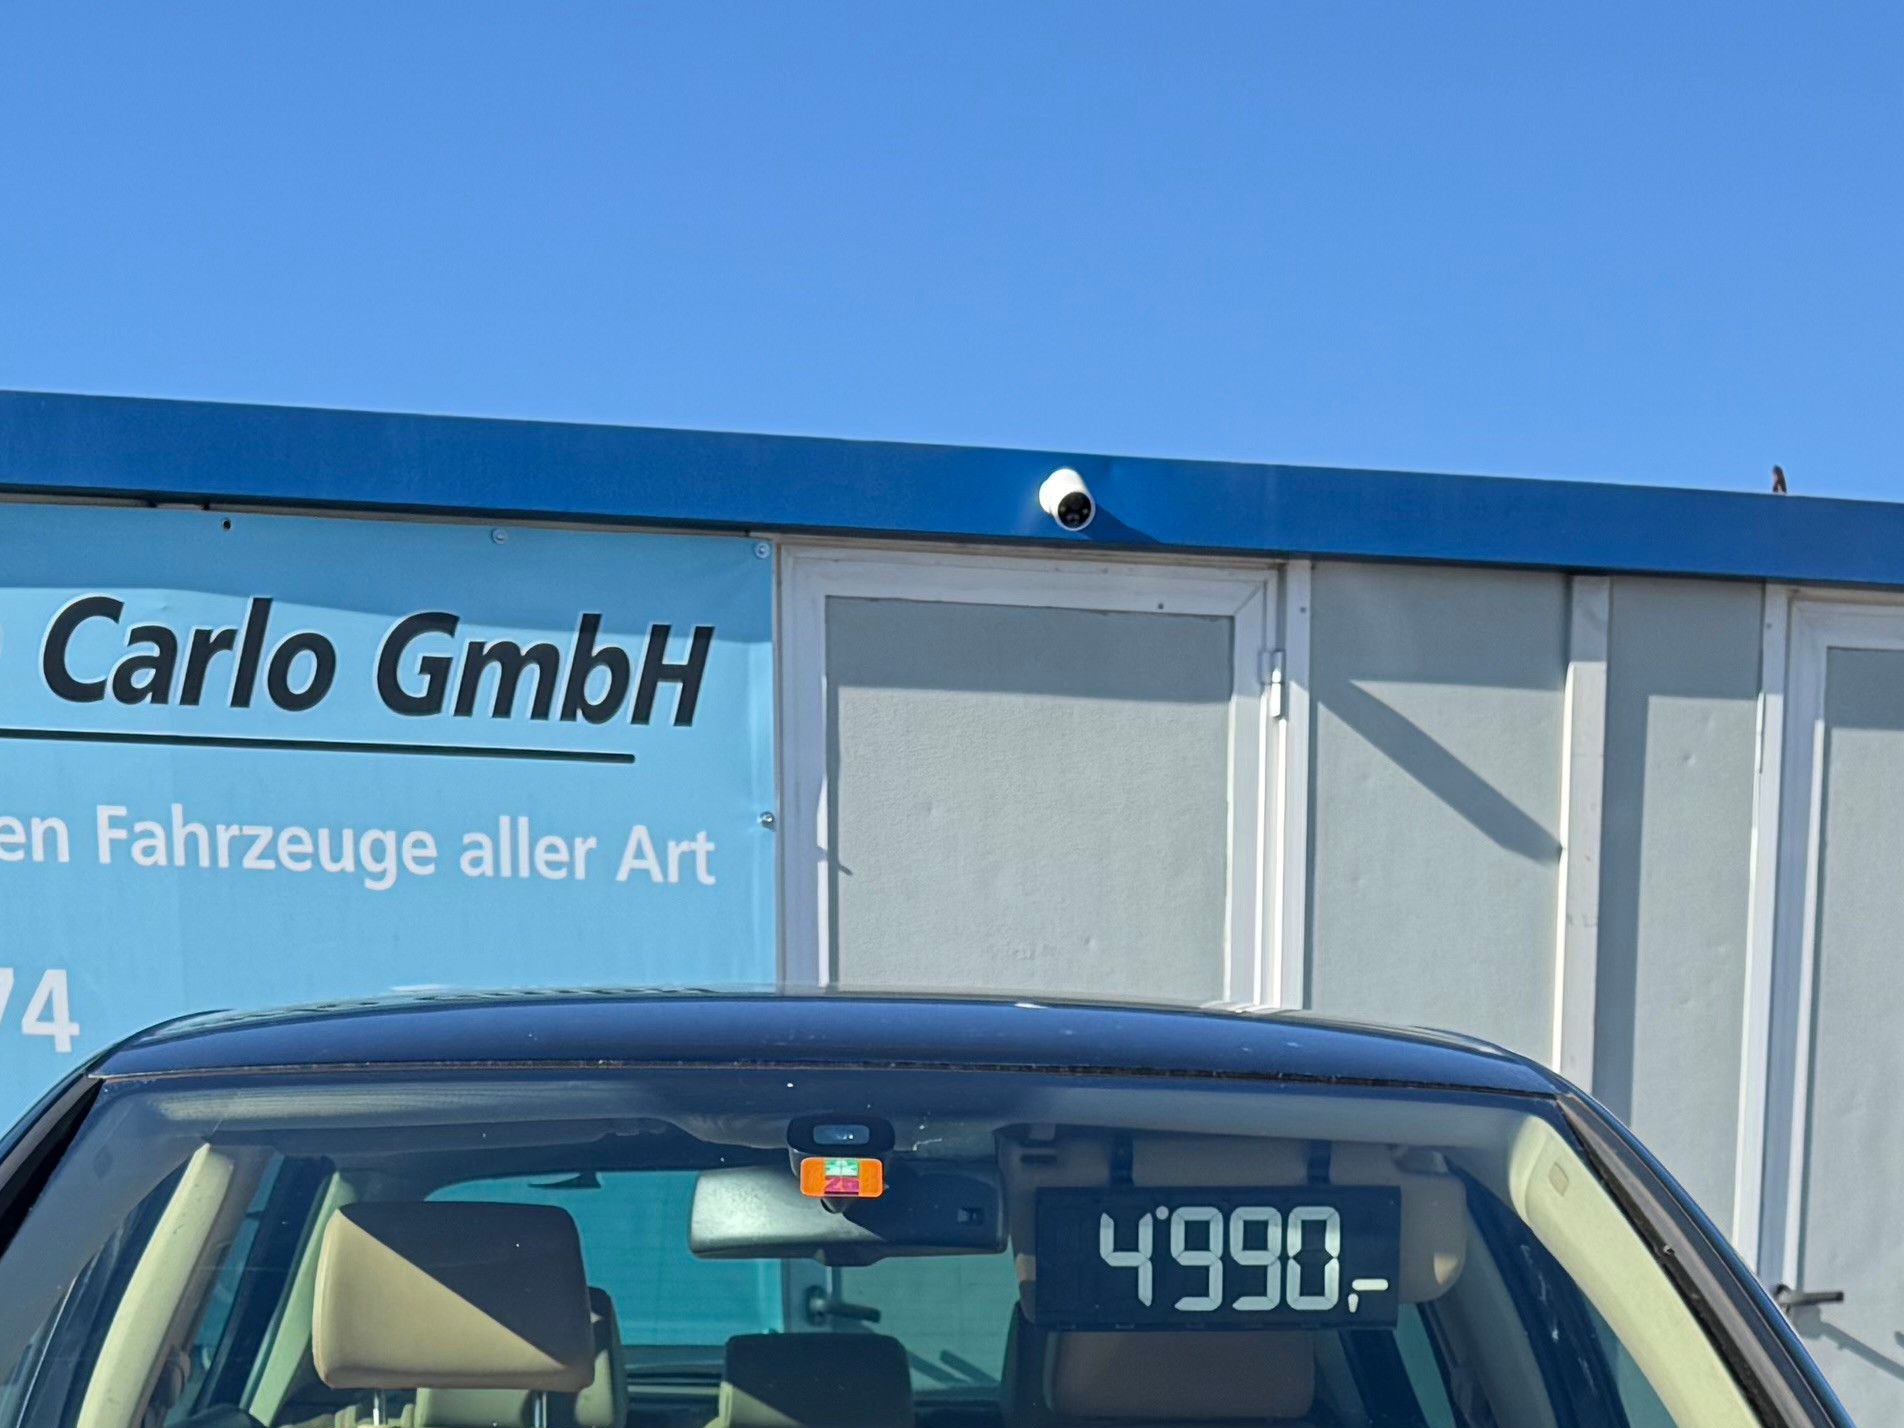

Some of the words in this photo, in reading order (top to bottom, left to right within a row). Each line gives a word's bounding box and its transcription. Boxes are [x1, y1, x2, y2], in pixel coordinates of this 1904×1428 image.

[41, 596, 337, 712] Carlo
[377, 611, 714, 727] GmbH
[97, 803, 438, 891] Fahrzeuge
[461, 815, 597, 880] aller
[617, 827, 716, 886] Art
